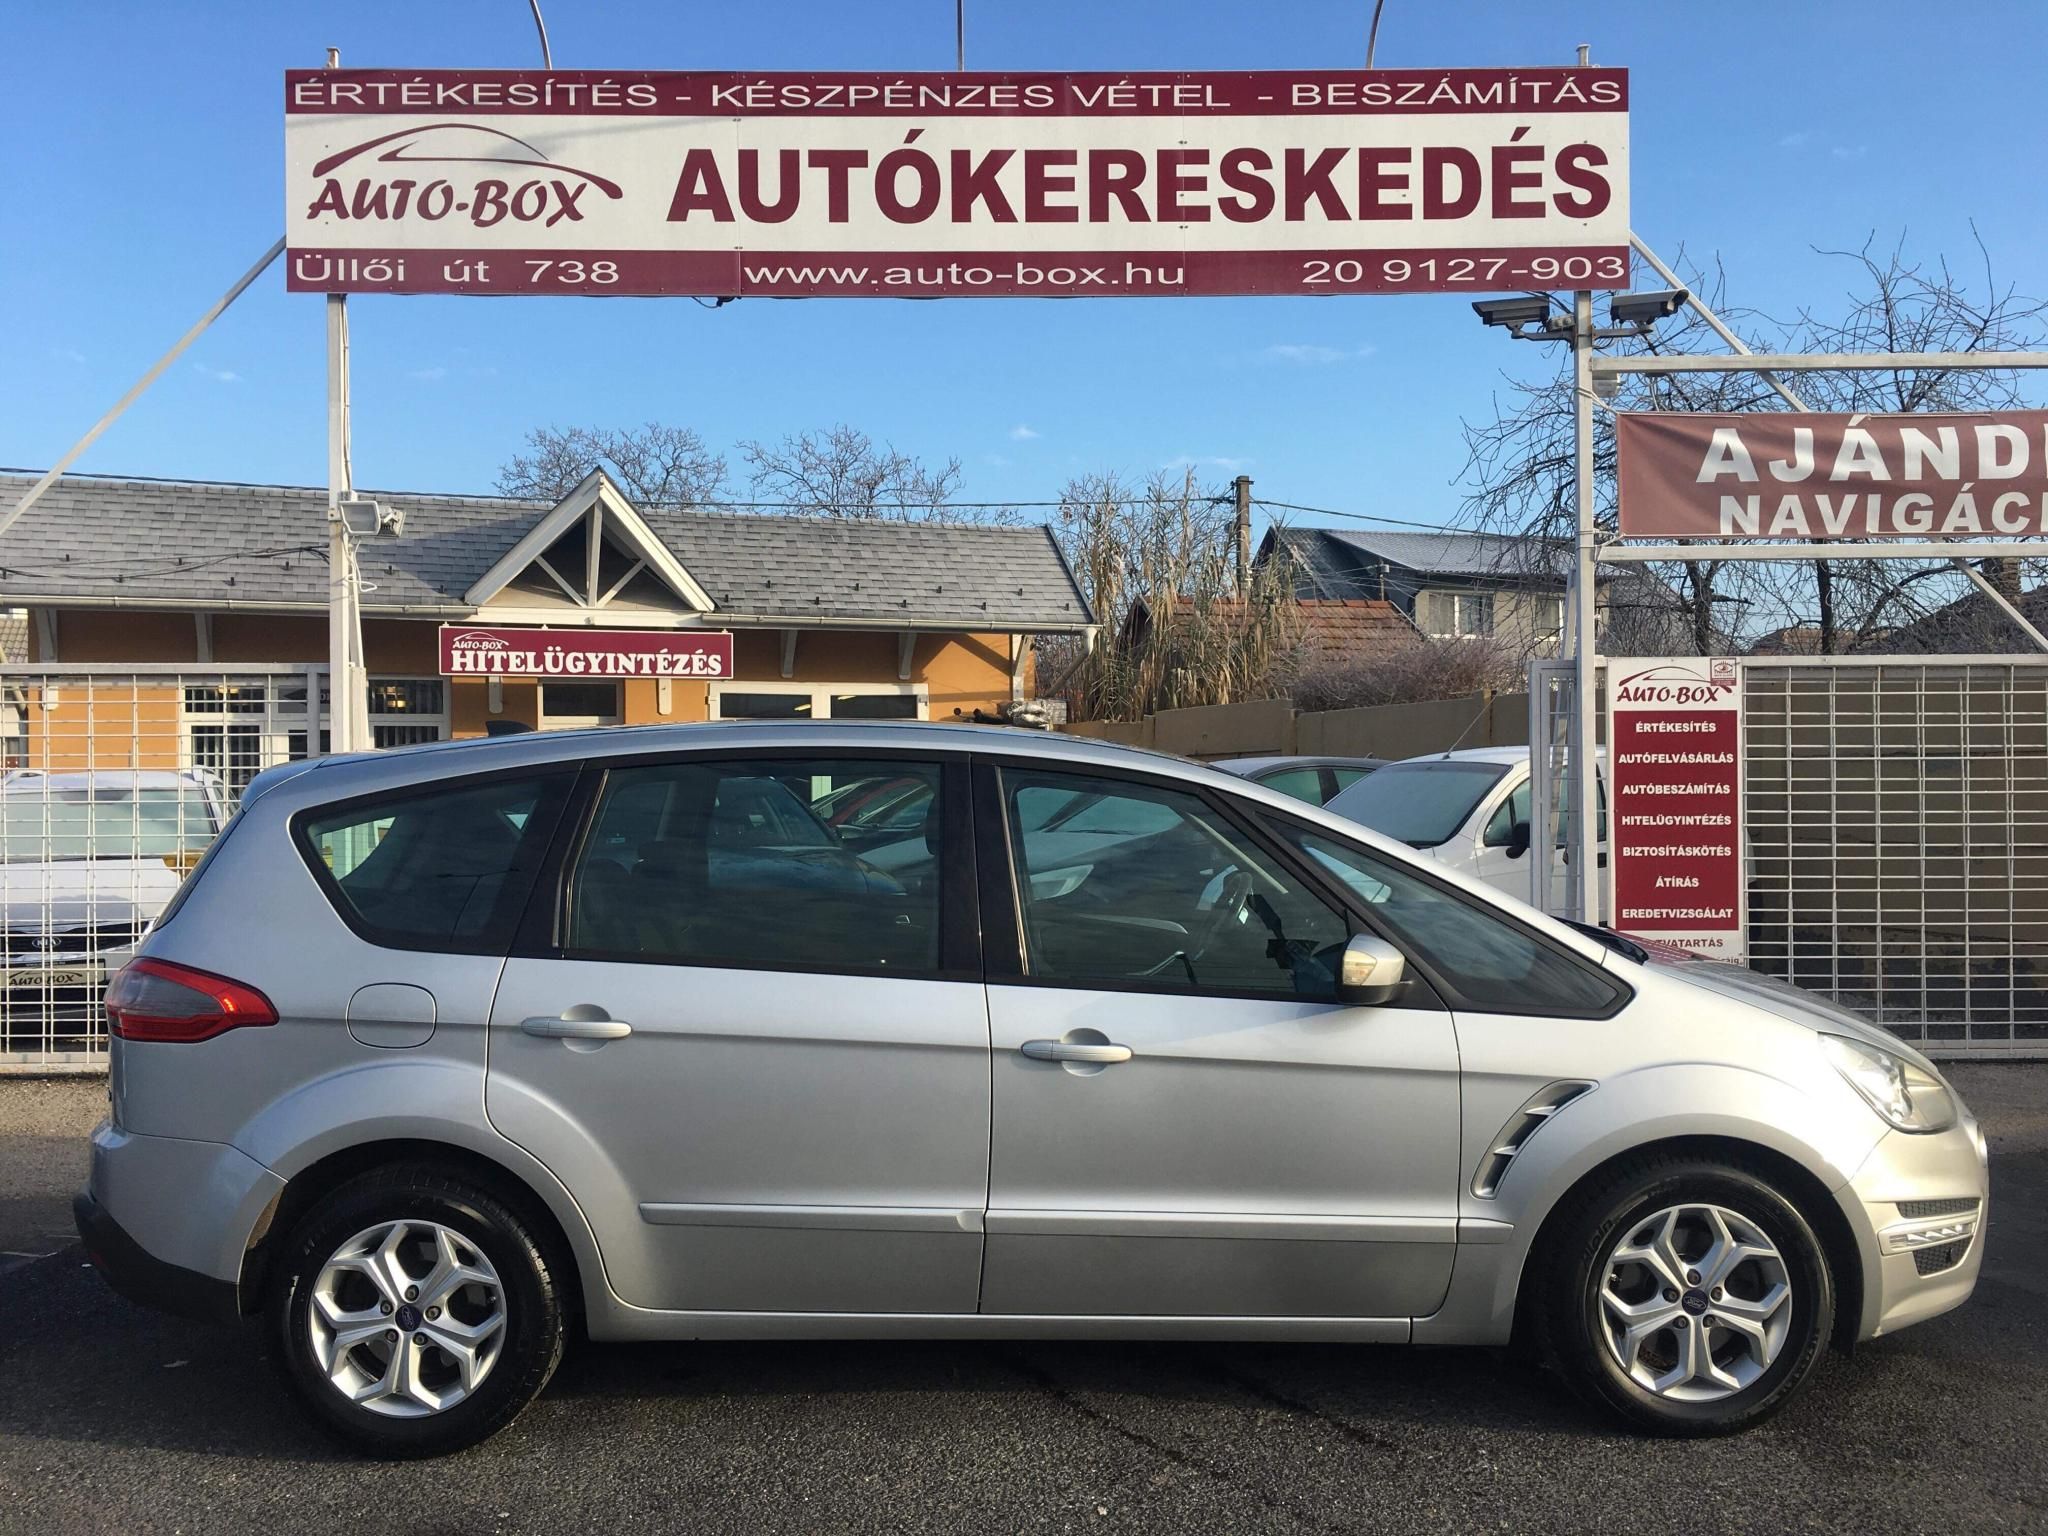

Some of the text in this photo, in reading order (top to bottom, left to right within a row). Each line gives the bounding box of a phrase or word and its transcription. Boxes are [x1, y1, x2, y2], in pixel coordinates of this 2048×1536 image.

[295, 78, 658, 108] ÉRTÉKESÍTÉS
[712, 79, 1056, 109] KÉSZPÉNZES
[1071, 79, 1231, 108] VÉTEL
[1292, 76, 1622, 106] BESZÁMÍTÁS
[666, 127, 1611, 224] AUTÓKERESKEDÉS
[306, 178, 588, 228] AUTO-BOX
[296, 254, 619, 284] Üllői út 738
[743, 262, 1185, 286] www.auto-box.hu
[1302, 256, 1625, 284] 20 9127-903
[1696, 415, 2048, 483] AJÁND
[452, 640, 502, 650] AUTO-BOX
[450, 646, 722, 676] HITELÜGYINTÉZÉS
[1617, 686, 1719, 704] AUTO-BOX
[1635, 721, 1717, 733] ÉRTÉKESÍTÉS
[1618, 752, 1734, 764] AUTÓFELVÁSÁRLÁS
[1622, 783, 1731, 795] AUTÓBESZÁMÍTÁS
[1621, 814, 1732, 826] HITELÜGYINTÉZÉS
[1622, 845, 1732, 857] BIZTOSÍTÁSKÖTÉS
[1655, 876, 1700, 888] ÁTÍRÁS
[1622, 907, 1734, 919] EREDETVIZSGÁLAT
